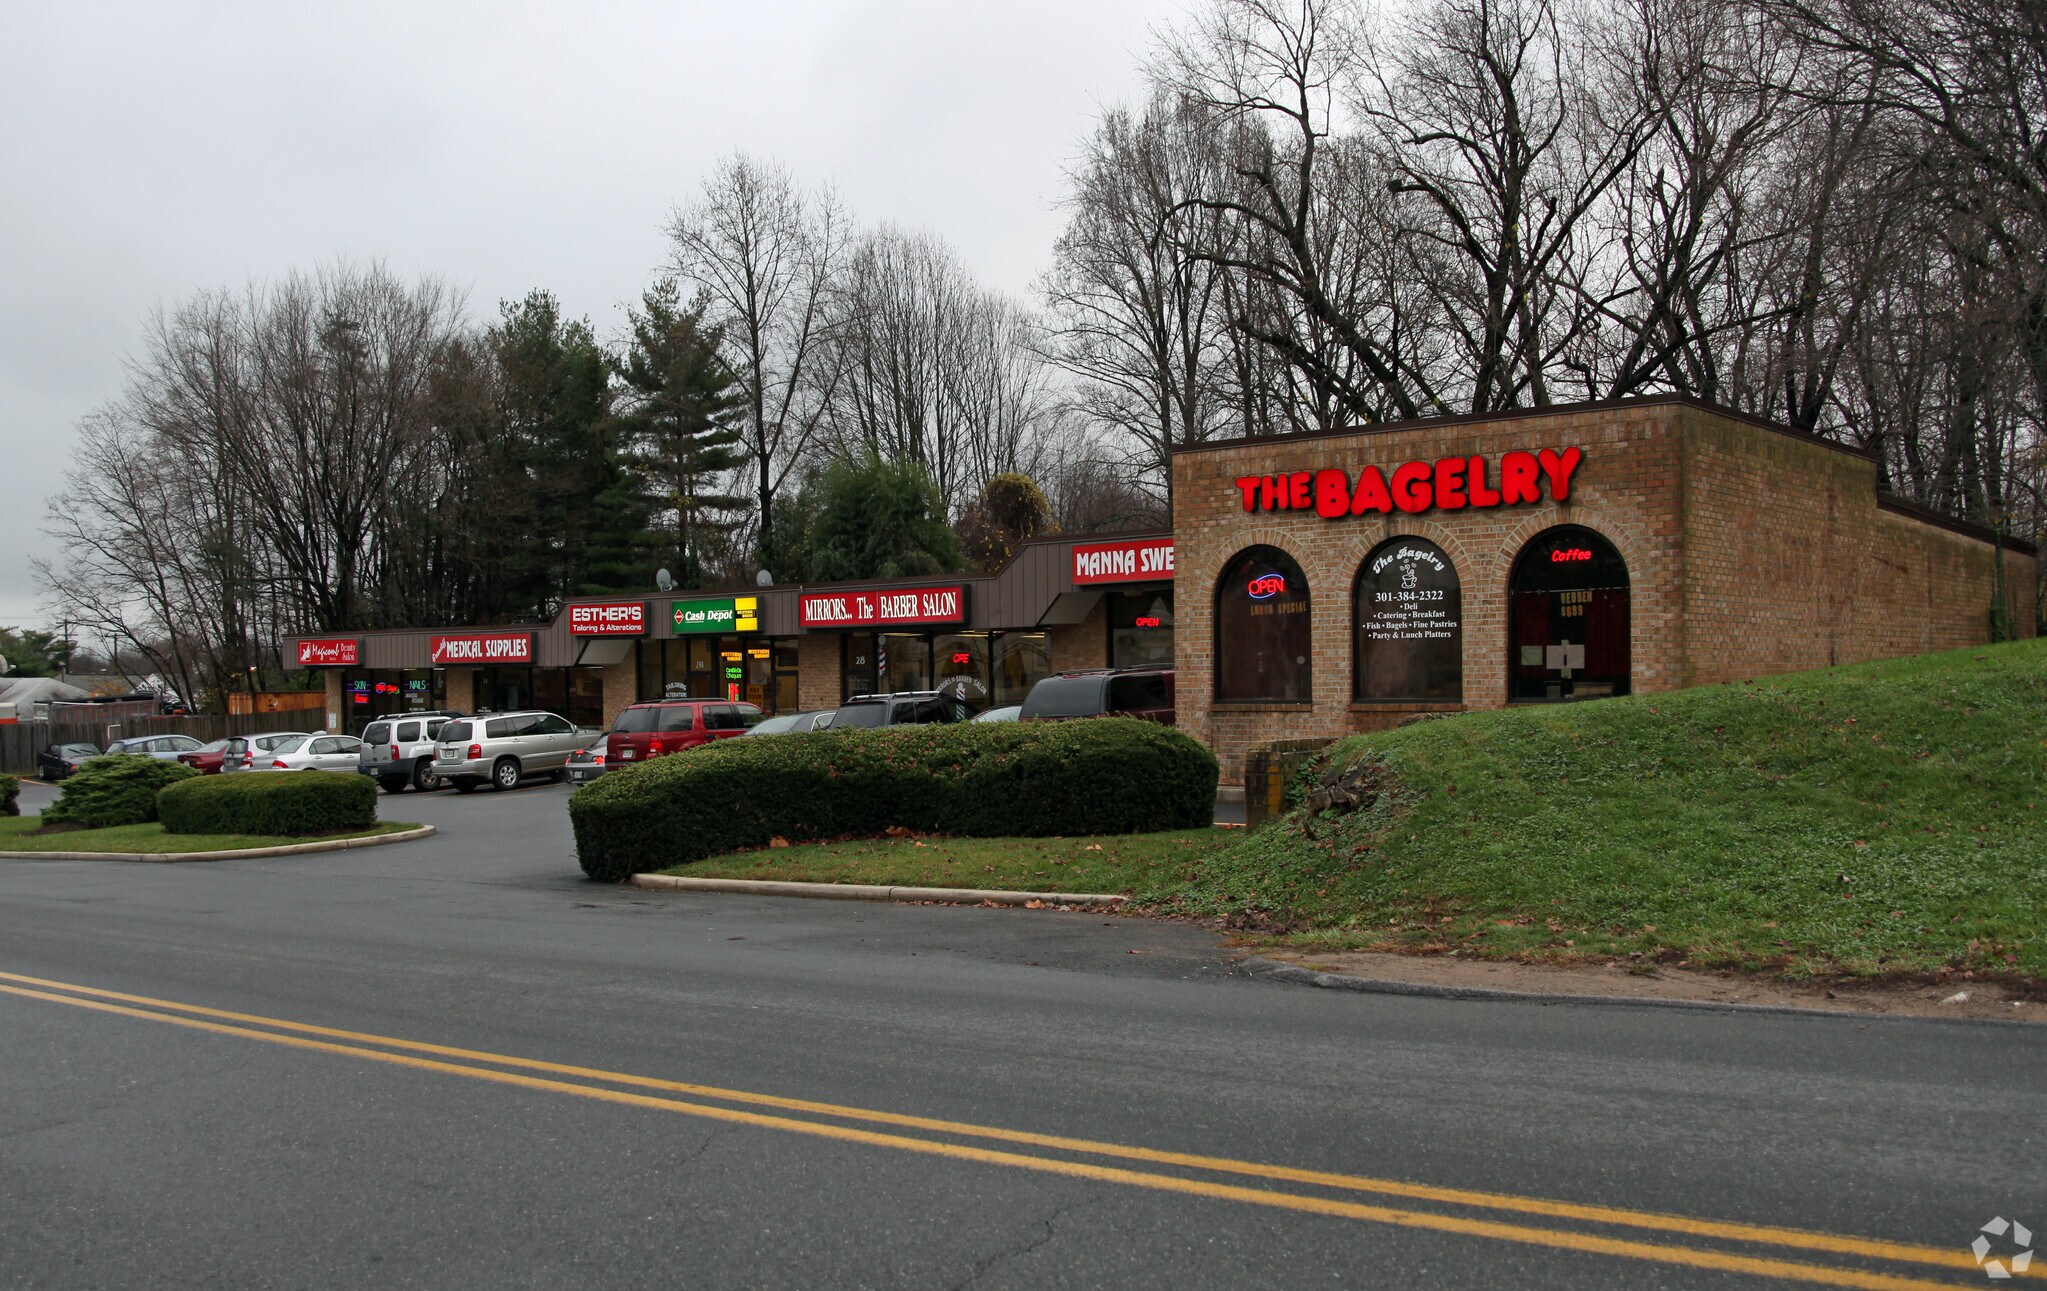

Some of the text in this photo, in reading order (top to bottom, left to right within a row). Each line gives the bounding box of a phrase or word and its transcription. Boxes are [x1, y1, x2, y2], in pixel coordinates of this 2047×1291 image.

[1235, 446, 1581, 519] THE BAGELRY
[1076, 546, 1174, 577] MANNA SWE
[1373, 546, 1445, 574] The Bagelry
[1552, 549, 1592, 562] Coffee
[1248, 578, 1285, 595] OPEN
[1375, 591, 1443, 602] 301-384-2322
[1561, 591, 1592, 604] REUBEN
[857, 597, 873, 619] The
[880, 594, 918, 618] BARBER
[923, 592, 957, 616] SALON
[1278, 601, 1308, 614] SPECIAL
[572, 606, 642, 622] ESTHER'S
[685, 610, 705, 622] Cash
[707, 609, 733, 623] Depot
[1377, 610, 1446, 619] Catering Breakfast
[573, 624, 598, 632] Tailoring
[606, 623, 642, 631] Alterations
[1135, 617, 1160, 627] OPEN
[1386, 621, 1408, 630] Bagels
[1430, 620, 1458, 628] Pastries
[1372, 630, 1452, 641] Party & Lunch Platters
[340, 642, 356, 652] Beauty
[446, 640, 483, 658] MEDICAL
[485, 638, 528, 657] SUPPLIES
[342, 652, 355, 661] Salon
[855, 656, 866, 665] 28
[354, 680, 367, 690] SKIN
[409, 680, 427, 690] NAILS
